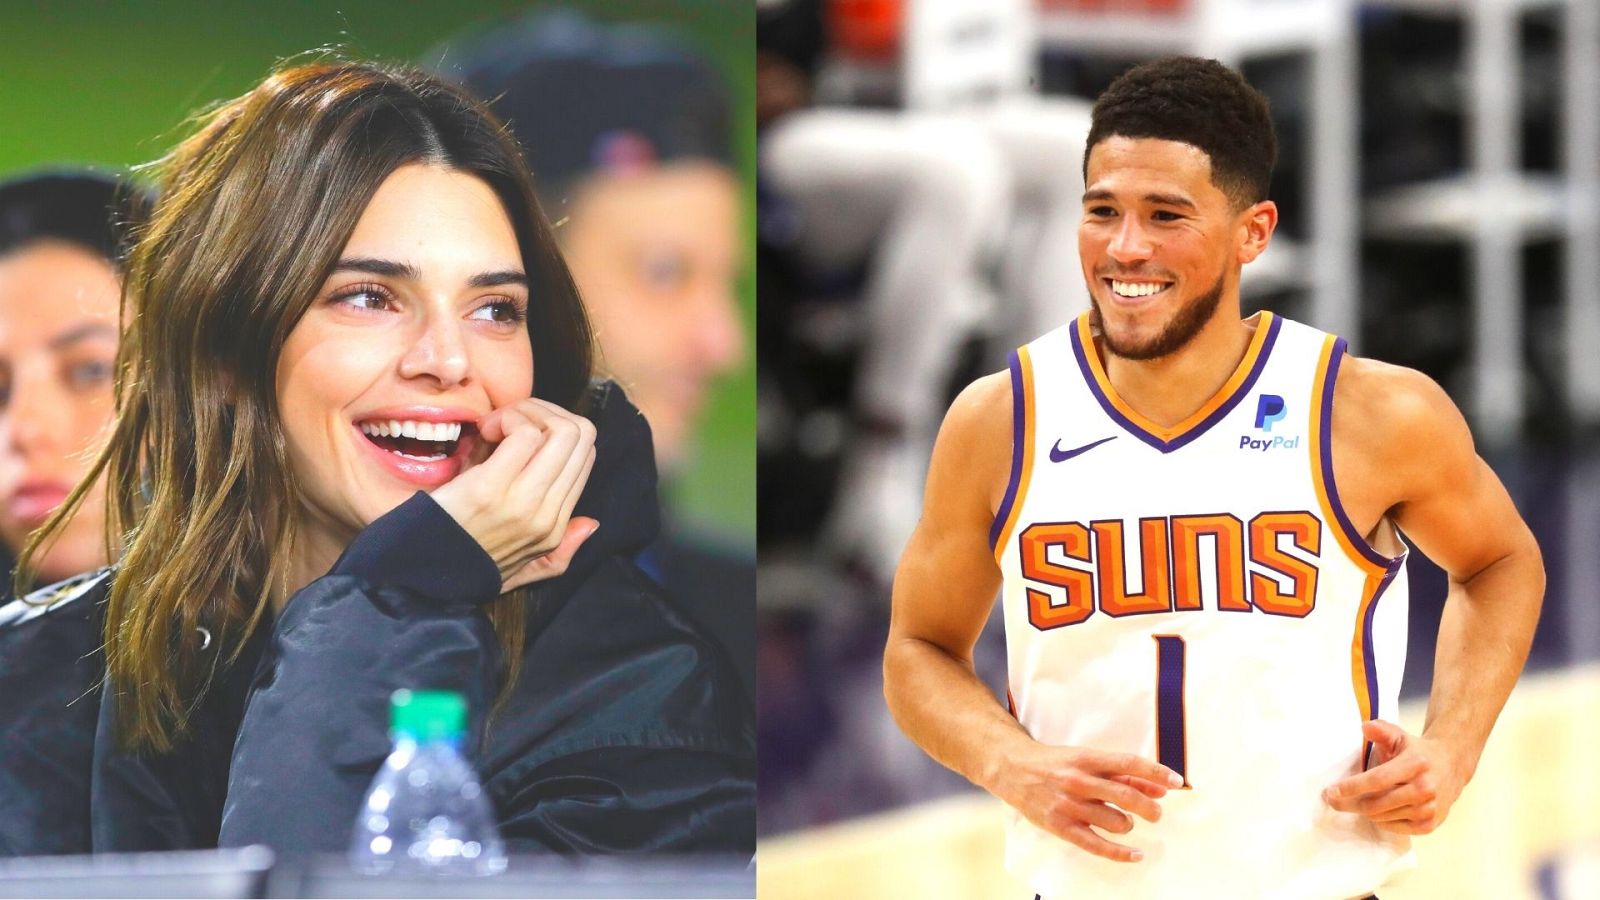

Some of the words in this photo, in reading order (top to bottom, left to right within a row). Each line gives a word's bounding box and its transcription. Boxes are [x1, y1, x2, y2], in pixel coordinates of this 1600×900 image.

[1239, 435, 1300, 452] PayPal
[1018, 510, 1322, 631] SUNS
[1151, 634, 1193, 790] 1
